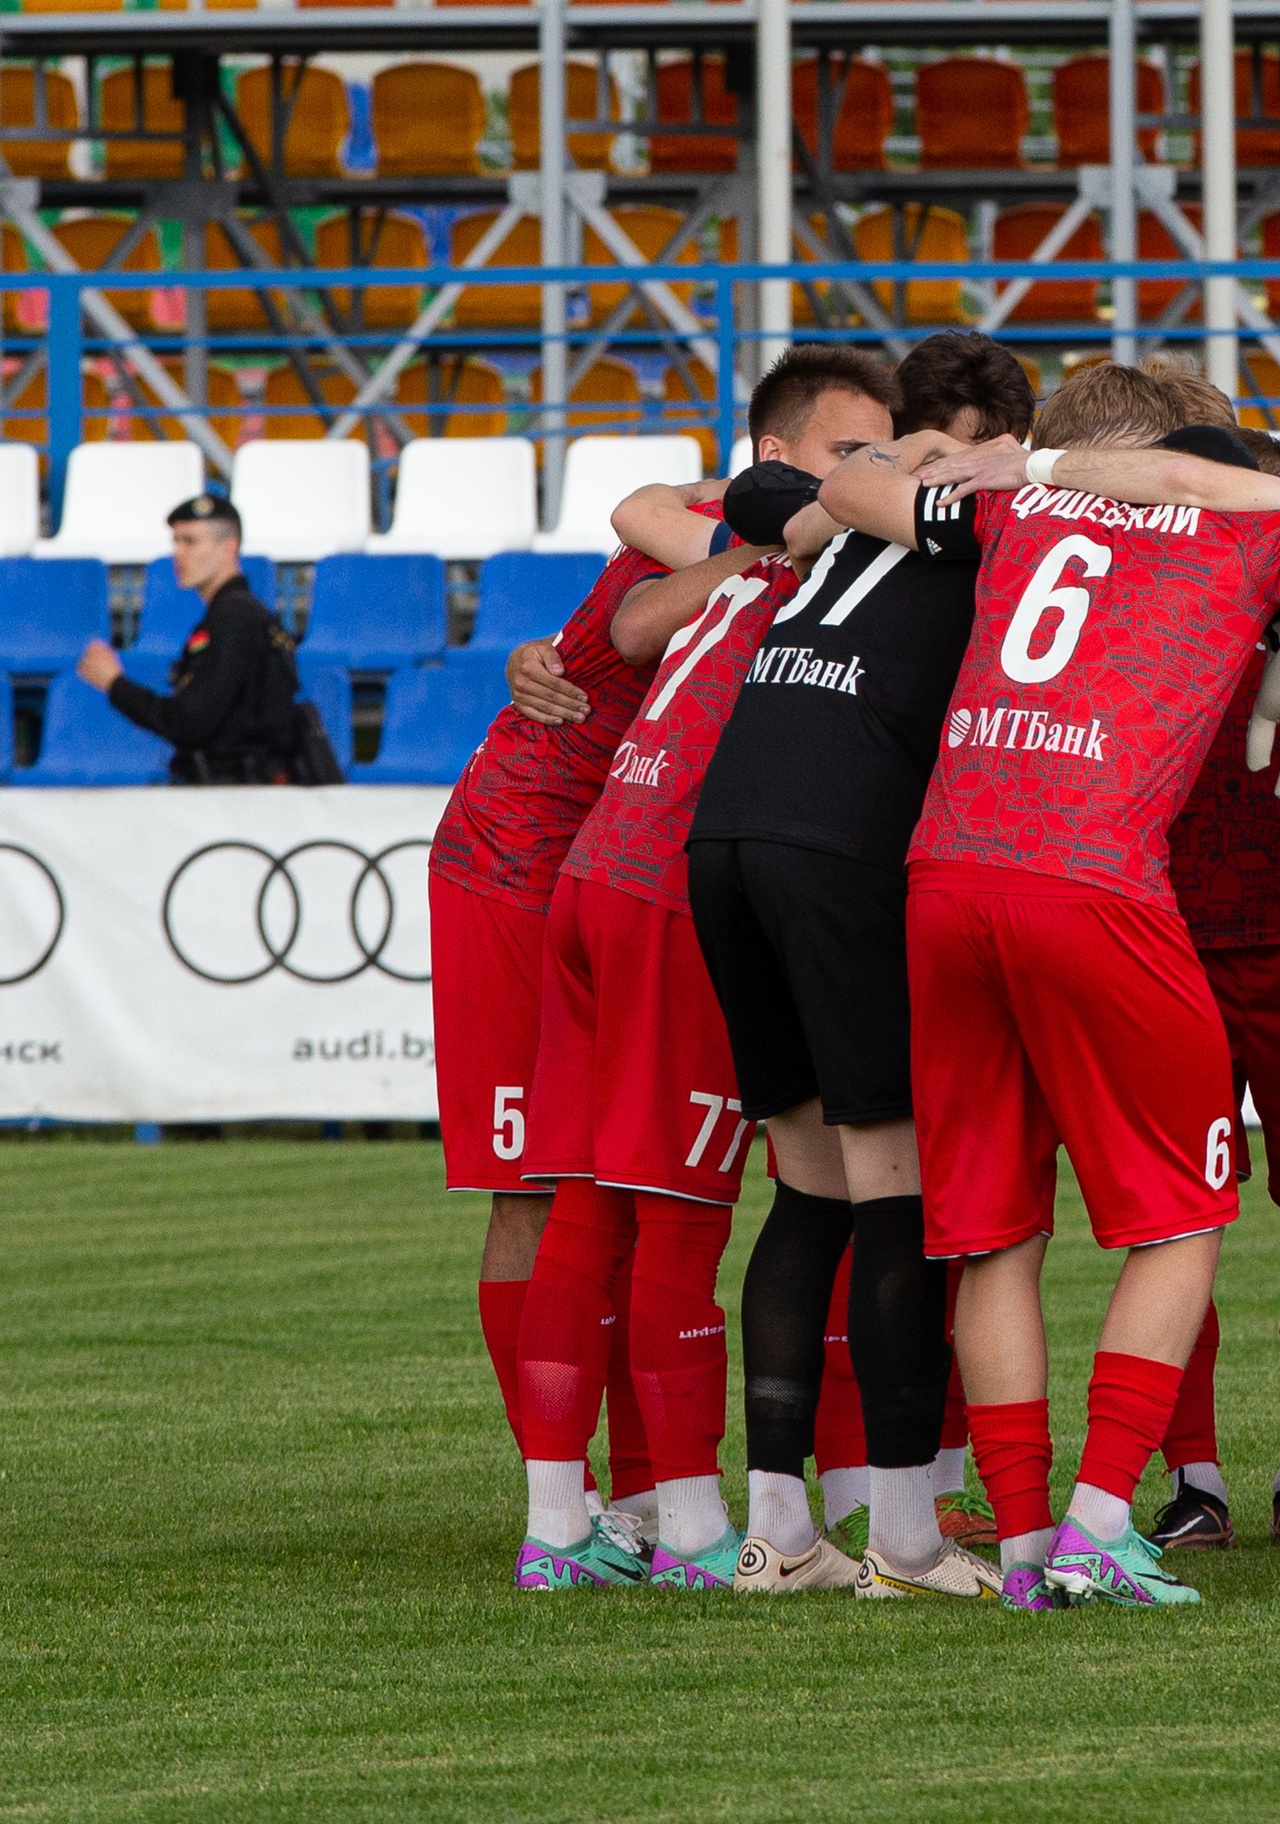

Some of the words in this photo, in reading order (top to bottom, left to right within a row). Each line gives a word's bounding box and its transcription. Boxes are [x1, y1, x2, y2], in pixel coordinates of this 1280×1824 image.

[1001, 534, 1112, 683] 6
[971, 707, 1108, 761] МТБанк
[493, 1086, 525, 1160] 5
[685, 1090, 749, 1173] 77
[1205, 1116, 1231, 1191] 6
